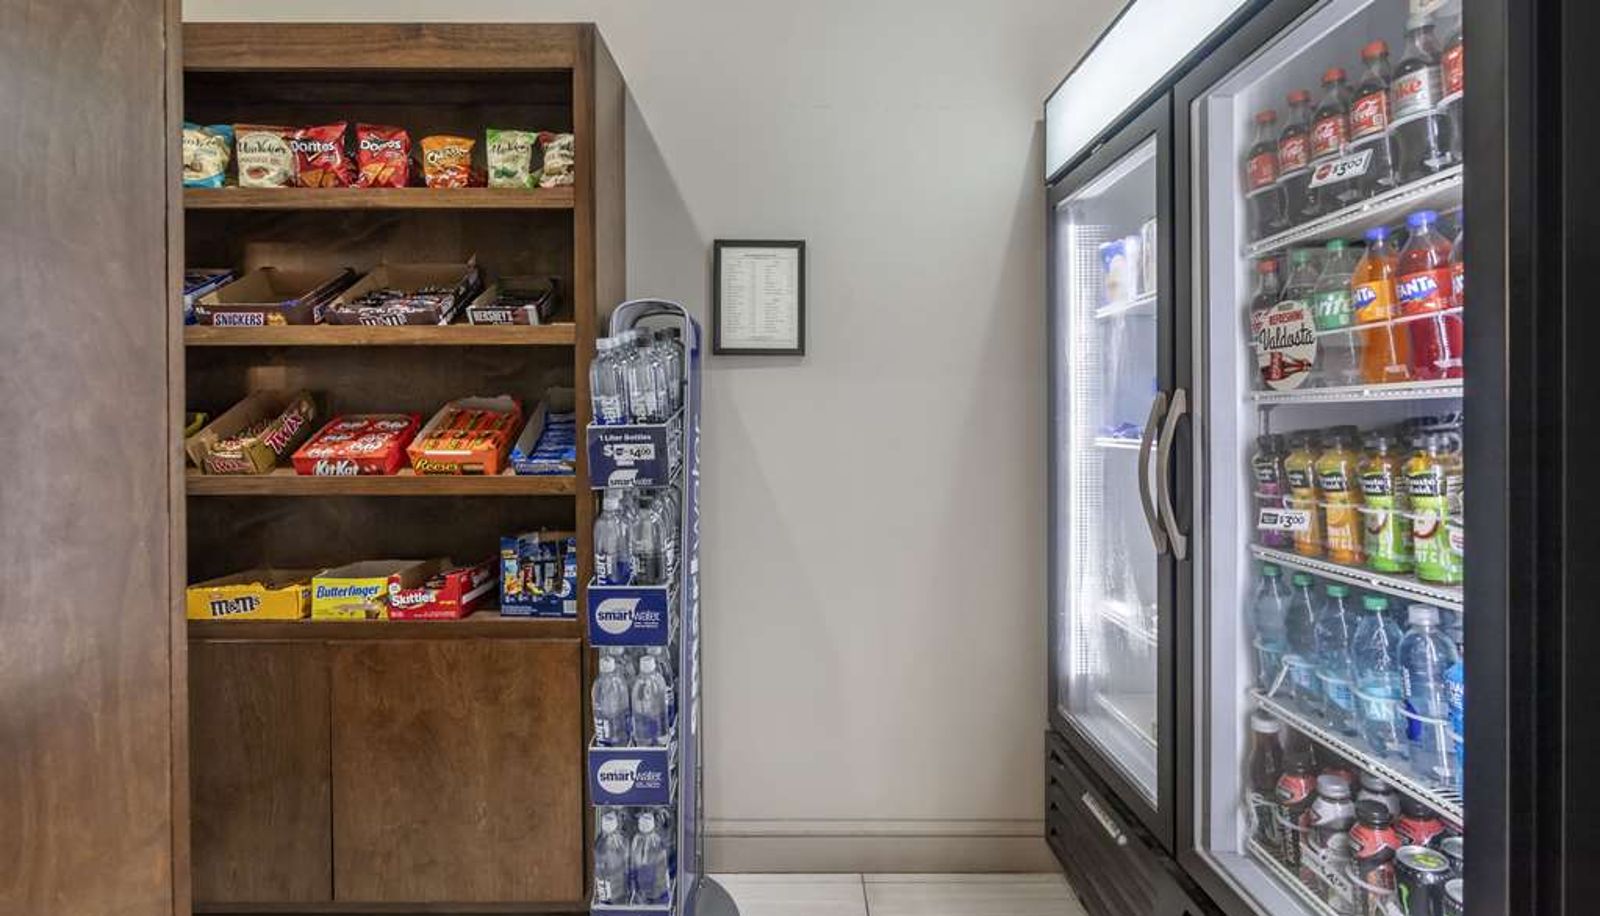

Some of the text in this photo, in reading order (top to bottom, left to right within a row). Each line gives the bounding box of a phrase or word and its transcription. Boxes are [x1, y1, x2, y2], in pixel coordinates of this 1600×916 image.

[215, 314, 262, 326] SNICKERS
[1260, 322, 1315, 350] Valdosta
[316, 585, 380, 599] Butterfinger
[391, 592, 437, 608] Skittles
